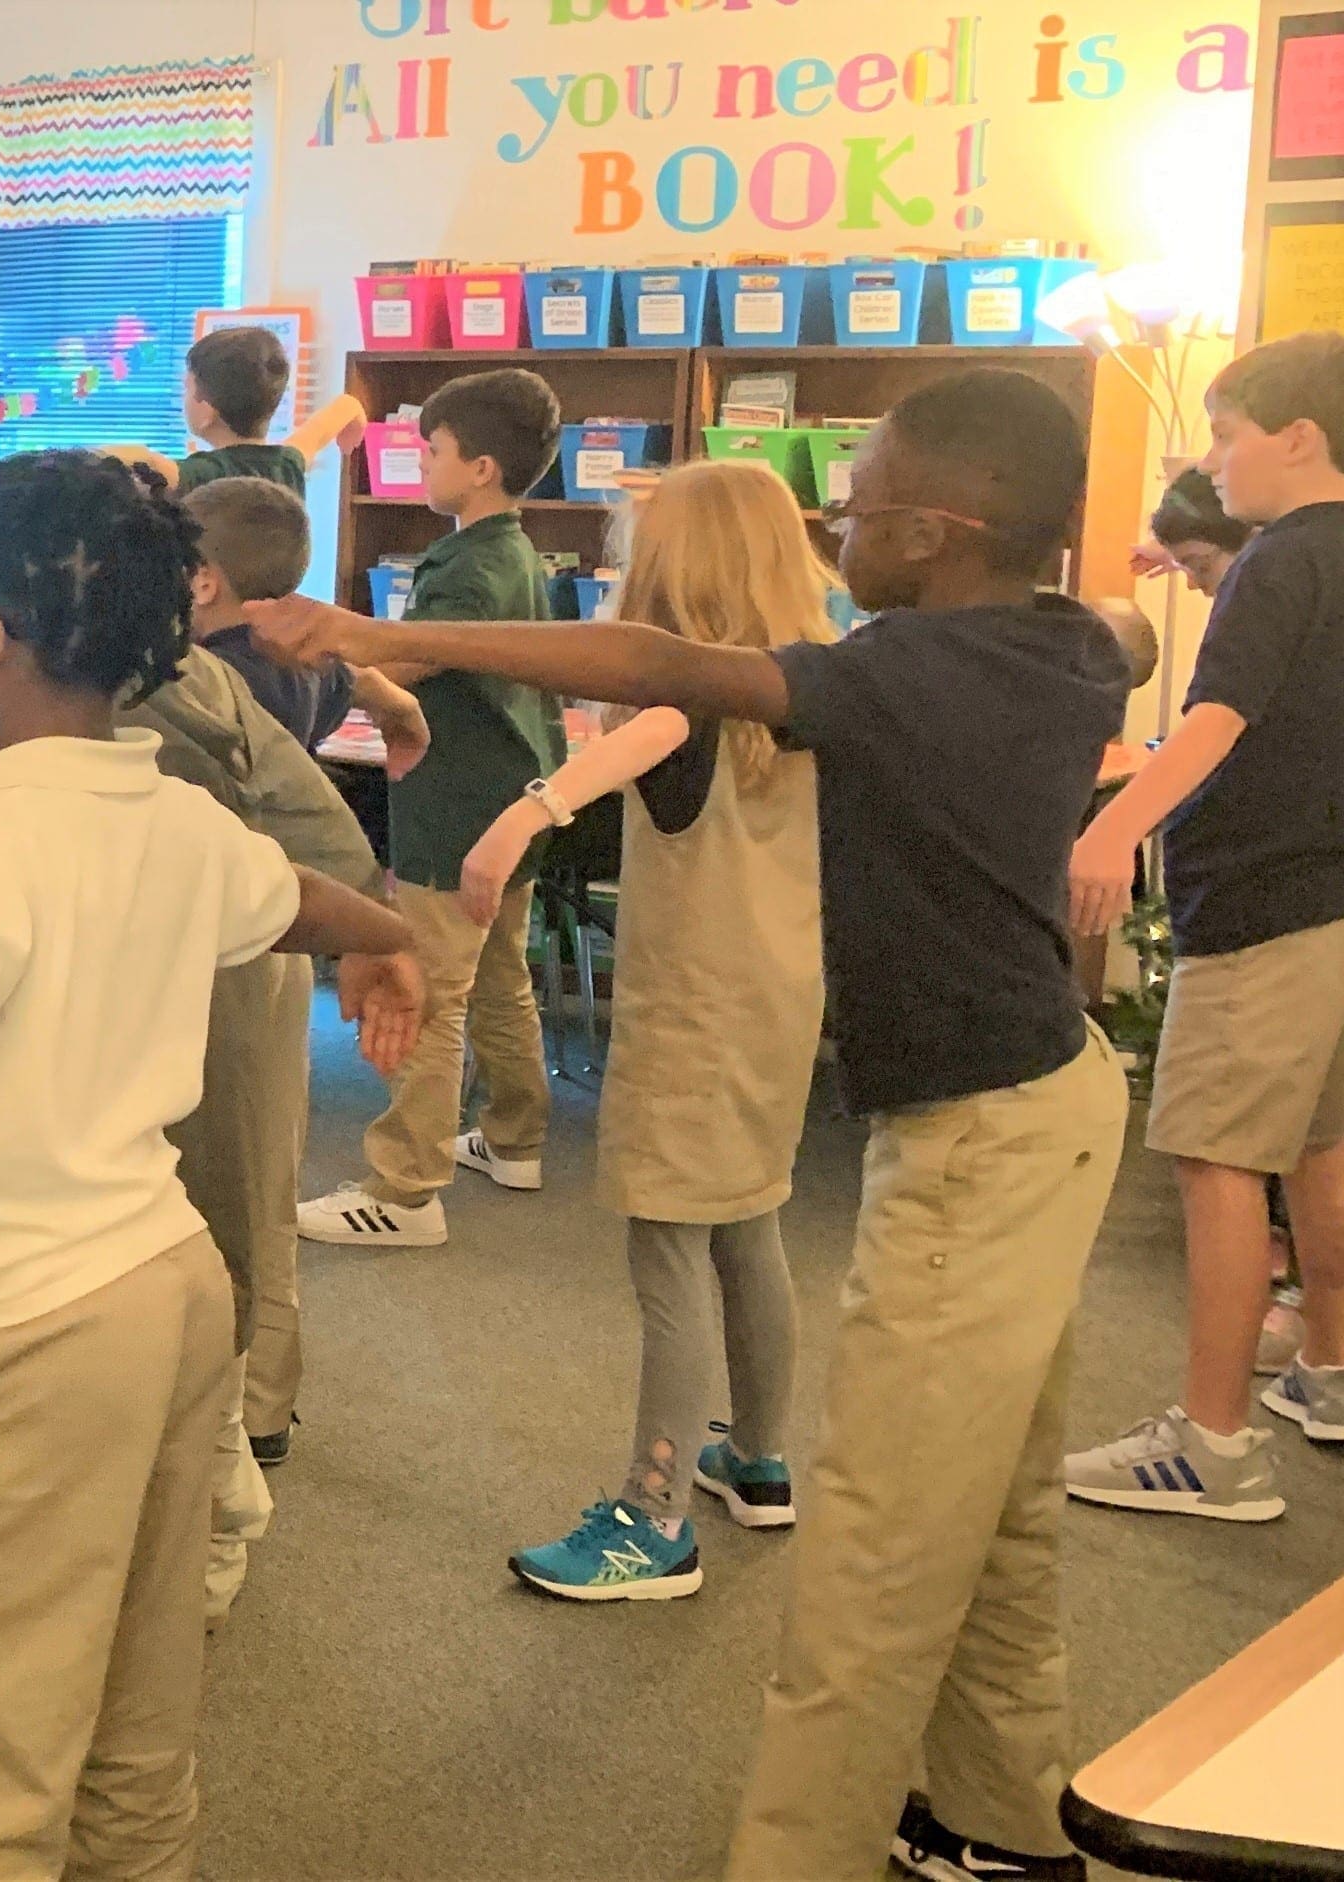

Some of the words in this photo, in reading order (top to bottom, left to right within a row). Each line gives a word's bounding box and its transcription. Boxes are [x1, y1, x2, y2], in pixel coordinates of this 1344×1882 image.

[306, 57, 452, 147] All
[497, 62, 683, 163] you
[712, 16, 982, 119] need
[1027, 13, 1126, 103] is
[1176, 22, 1255, 94] a
[574, 118, 991, 235] BOOK!
